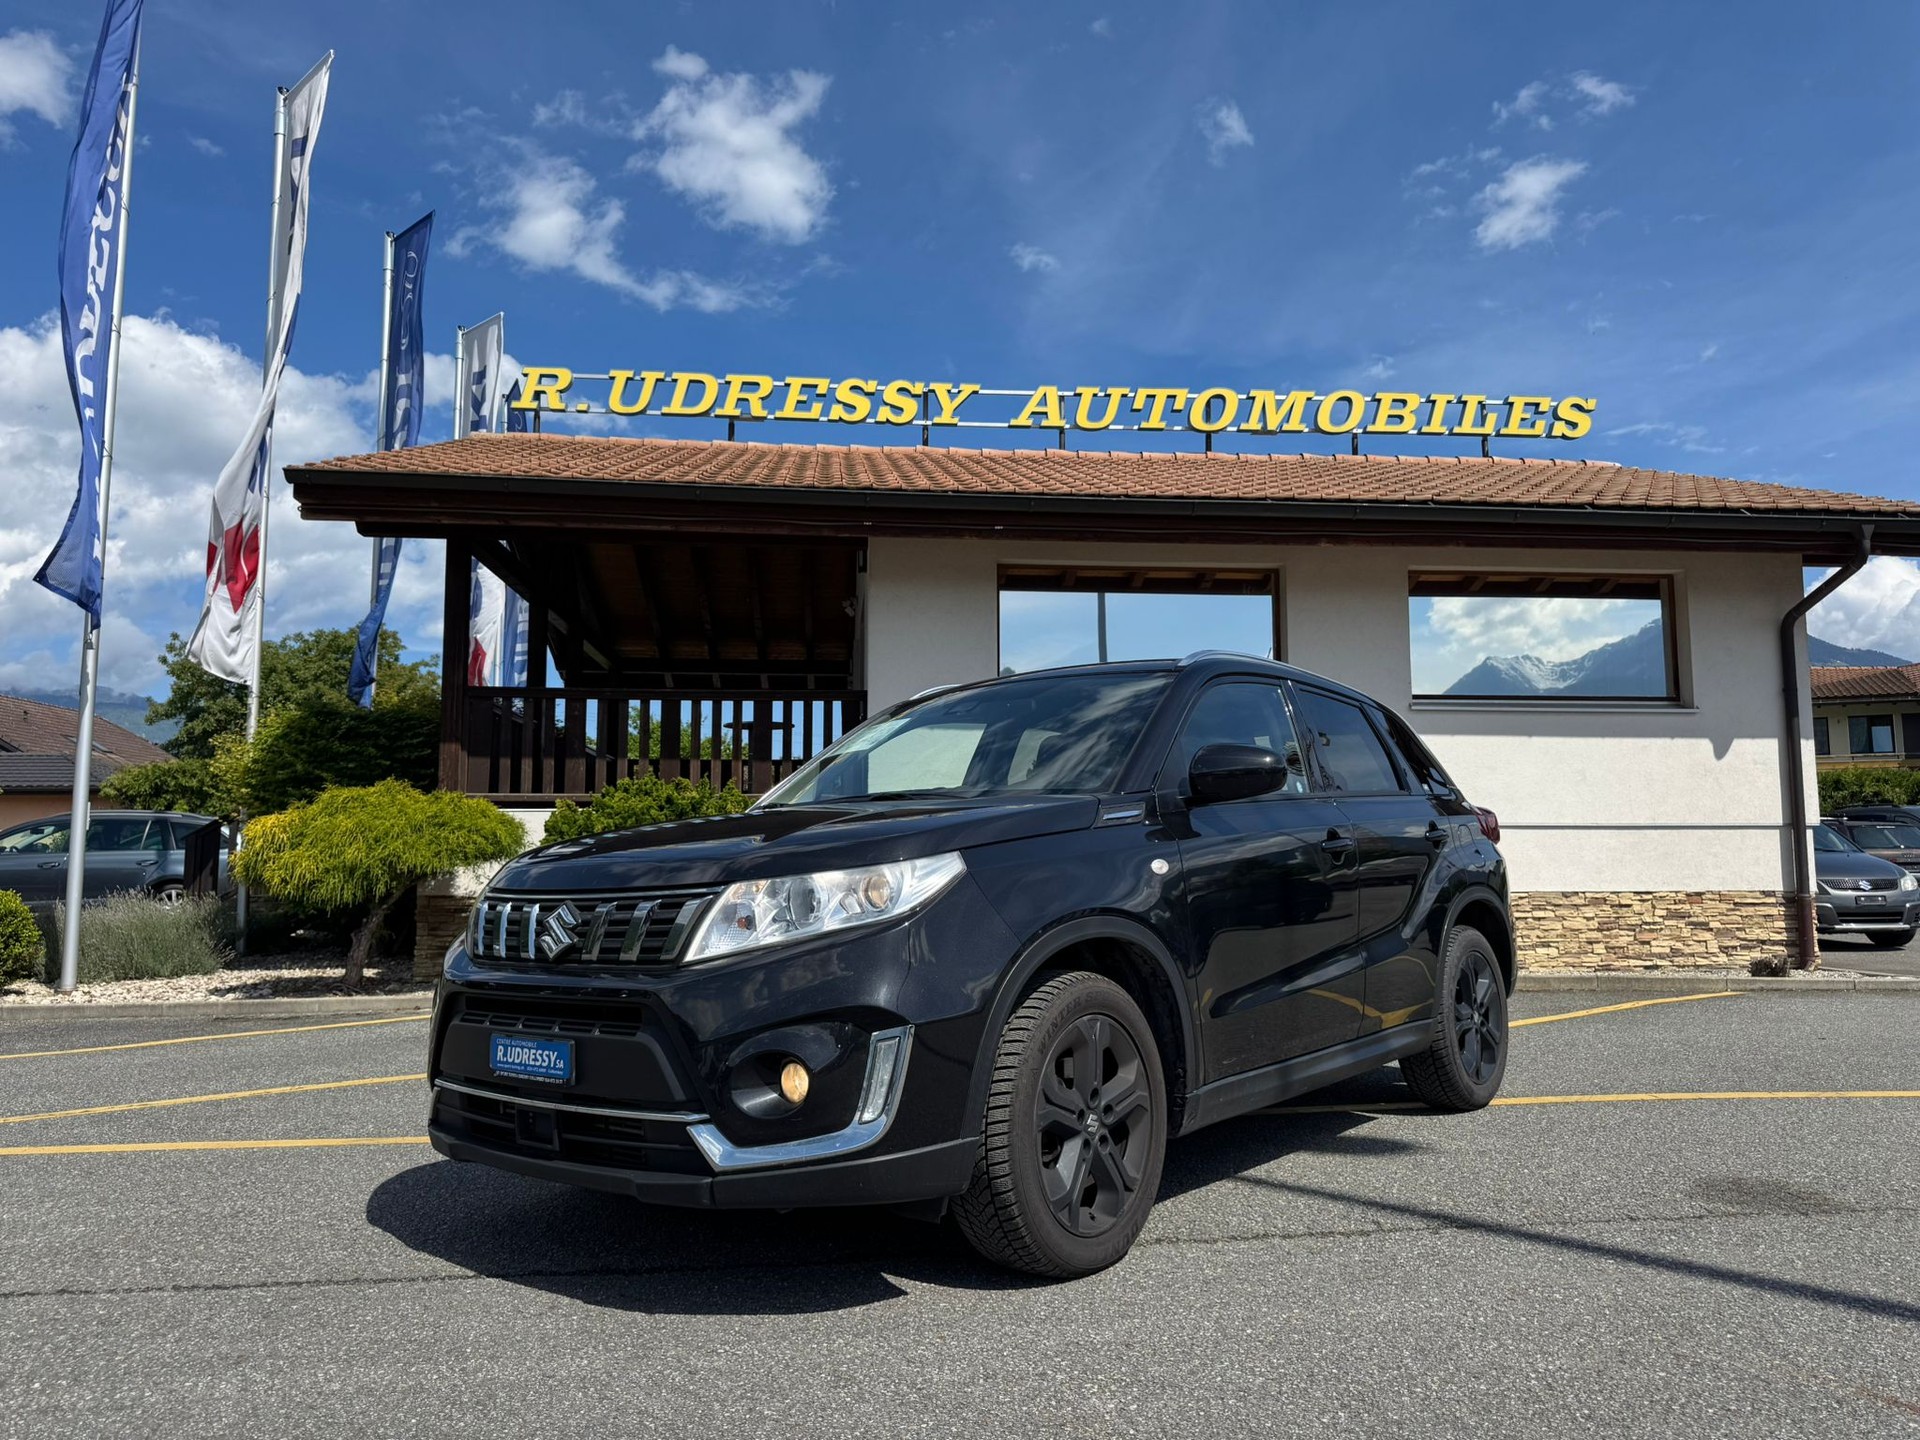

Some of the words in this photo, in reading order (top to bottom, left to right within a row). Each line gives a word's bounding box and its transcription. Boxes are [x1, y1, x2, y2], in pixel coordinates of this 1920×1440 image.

[1009, 384, 1598, 440] AUTOMOBILES
[1038, 997, 1081, 1054] WINTER
[555, 1059, 564, 1069] SA
